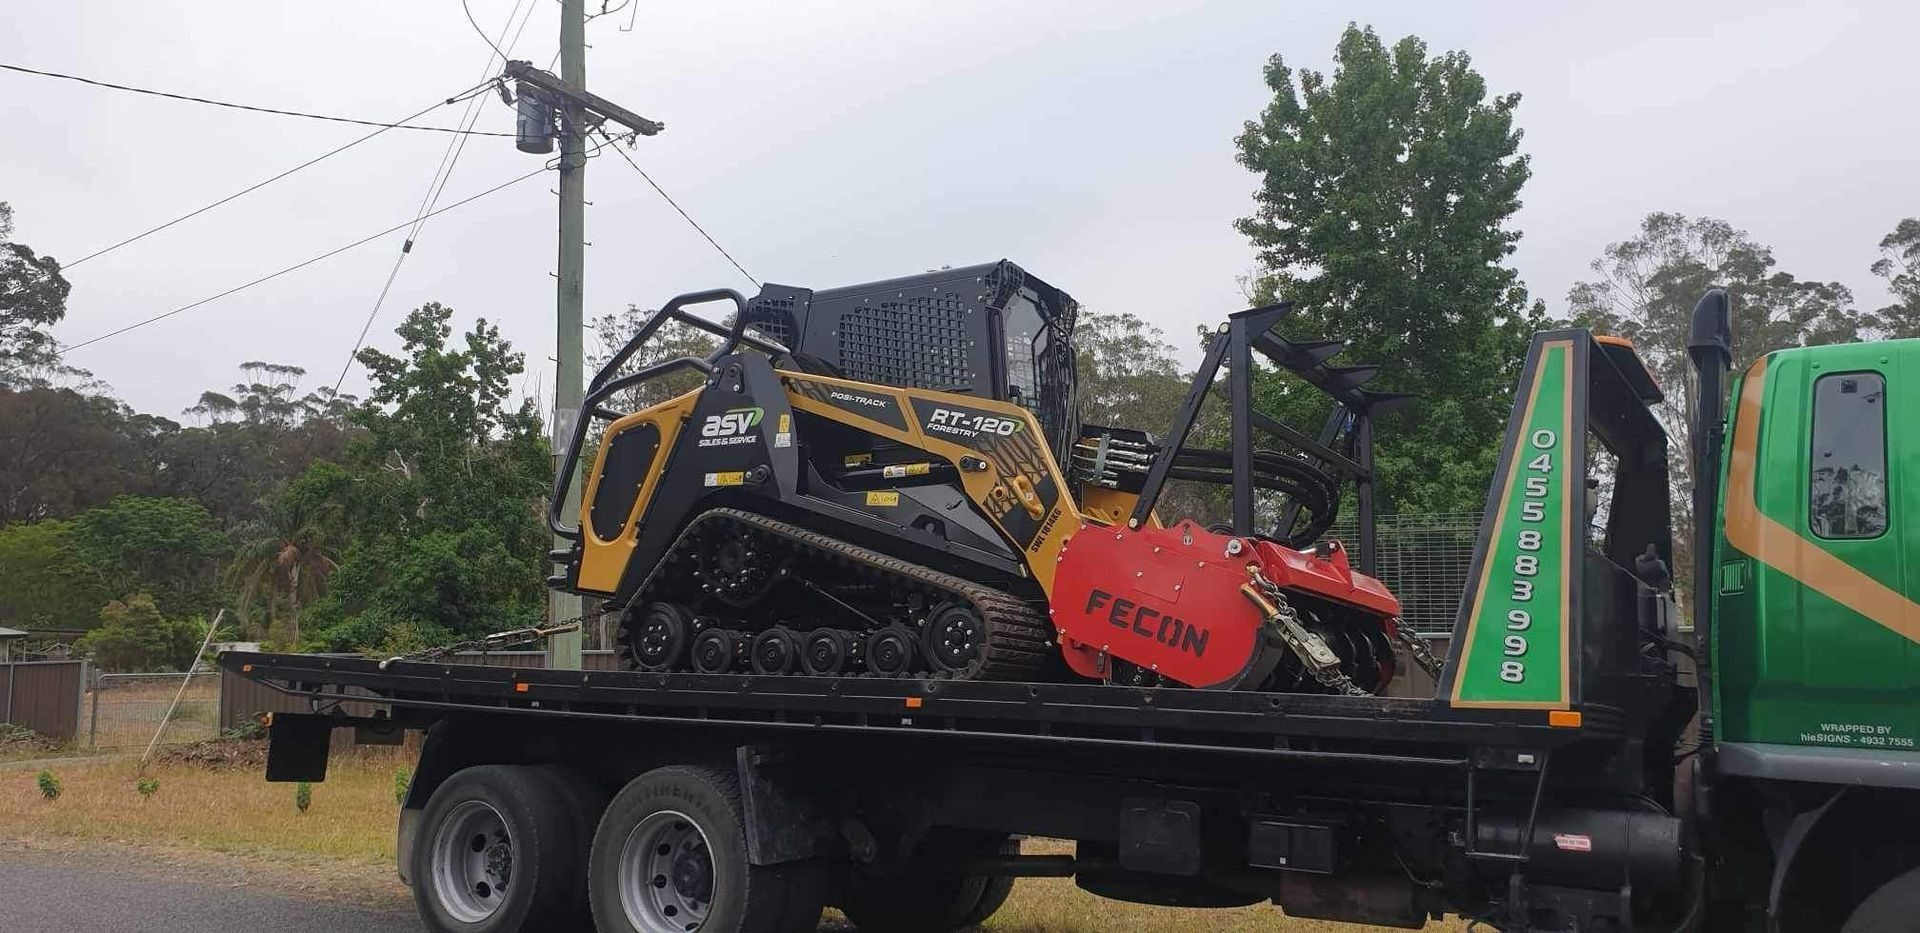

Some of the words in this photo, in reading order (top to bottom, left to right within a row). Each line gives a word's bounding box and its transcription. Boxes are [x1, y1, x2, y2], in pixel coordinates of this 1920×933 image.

[830, 392, 887, 408] POSI-TRACK
[930, 408, 1015, 436] RT-120
[927, 423, 979, 439] FORESTRY
[698, 438, 721, 448] SALES
[721, 437, 729, 446] &
[729, 435, 758, 445] SERVICE
[1031, 535, 1046, 553] SWL
[1042, 508, 1062, 536] 1814KG
[1085, 589, 1211, 657] FECON
[1820, 723, 1875, 734] WRAPPED
[1877, 725, 1892, 735] BY
[1860, 736, 1886, 746] 4932
[1888, 737, 1914, 747] 7555
